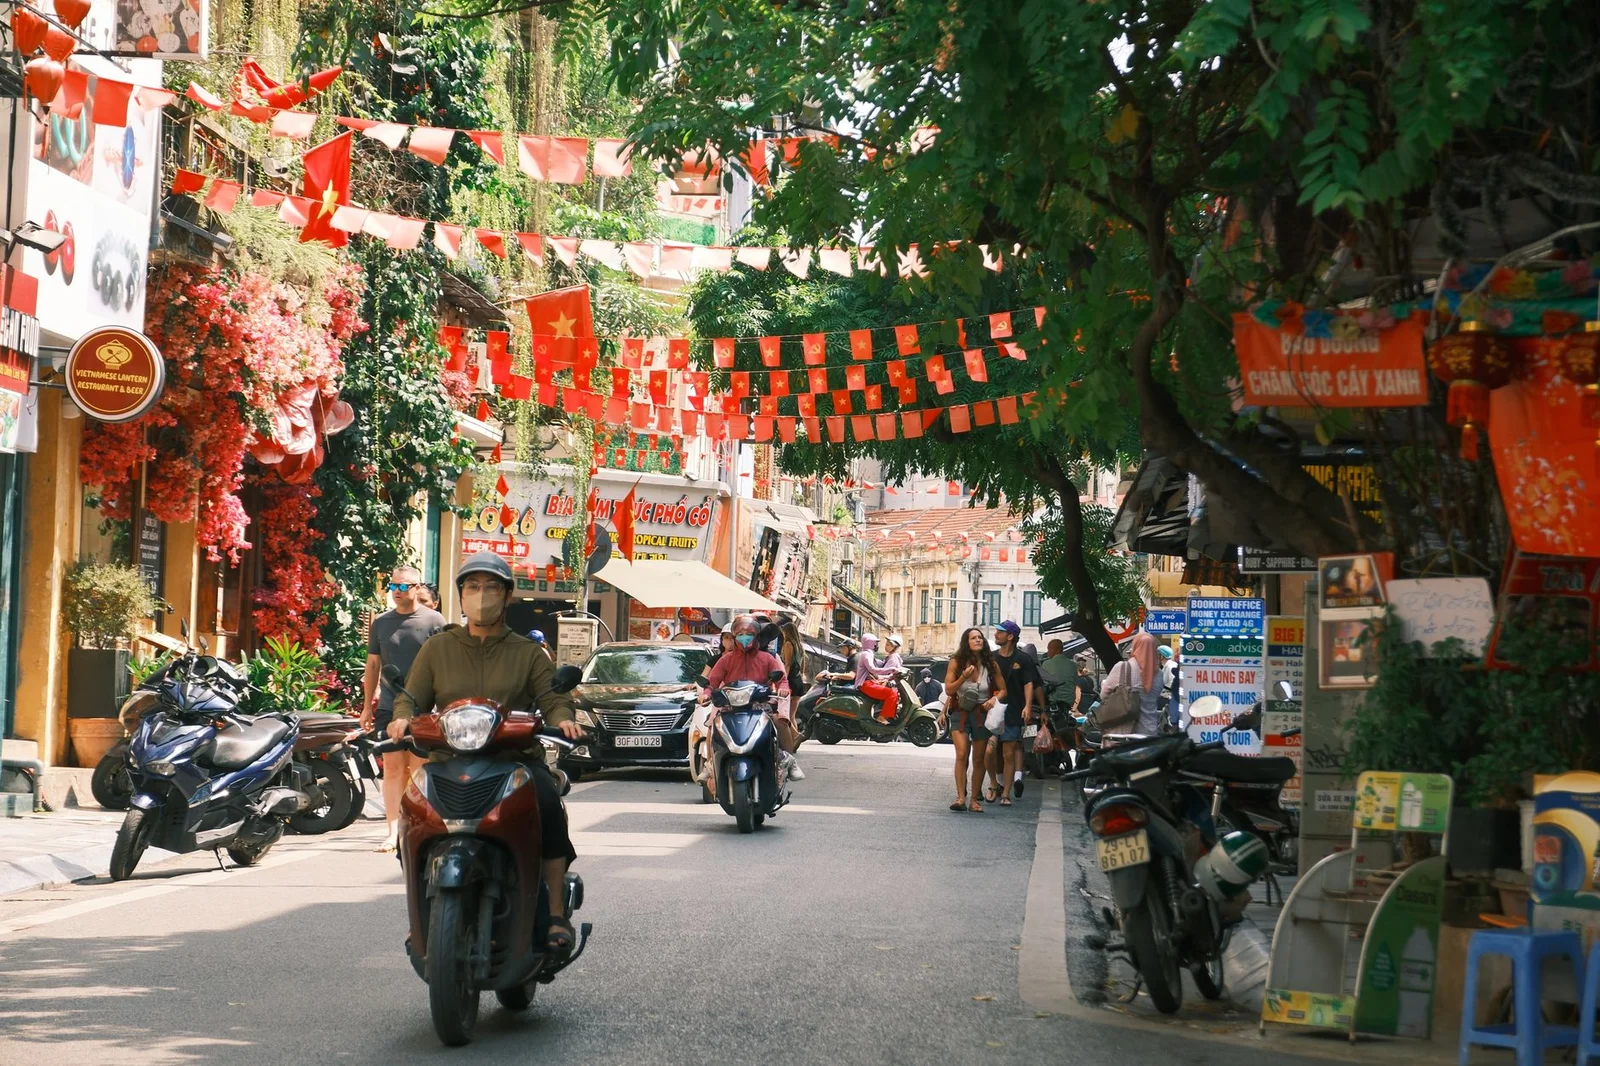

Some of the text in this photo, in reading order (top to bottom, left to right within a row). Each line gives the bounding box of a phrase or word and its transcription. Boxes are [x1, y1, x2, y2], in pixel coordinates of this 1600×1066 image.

[76, 369, 148, 383] VIETNAMESE LANTERN
[77, 381, 118, 392] RESTAURANT
[1374, 369, 1421, 396] XANH
[653, 494, 688, 526] PHỐ
[688, 496, 712, 527] CỔ
[668, 536, 698, 550] FRUITS
[1245, 557, 1260, 568] RUBY
[1266, 556, 1296, 568] SAPPHIRE
[1191, 600, 1261, 610] BOOKING OFFICE
[1222, 611, 1261, 619] EXCHANGE
[1148, 620, 1168, 631] HÀNG
[1198, 619, 1254, 628] SIM CARD 4G
[1273, 628, 1295, 643] BIG
[1196, 670, 1256, 684] HA LONG BAY
[1231, 692, 1256, 705] TOURS
[1227, 733, 1251, 745] TOUR
[1336, 795, 1345, 803] XE
[1101, 847, 1144, 869] 861.07
